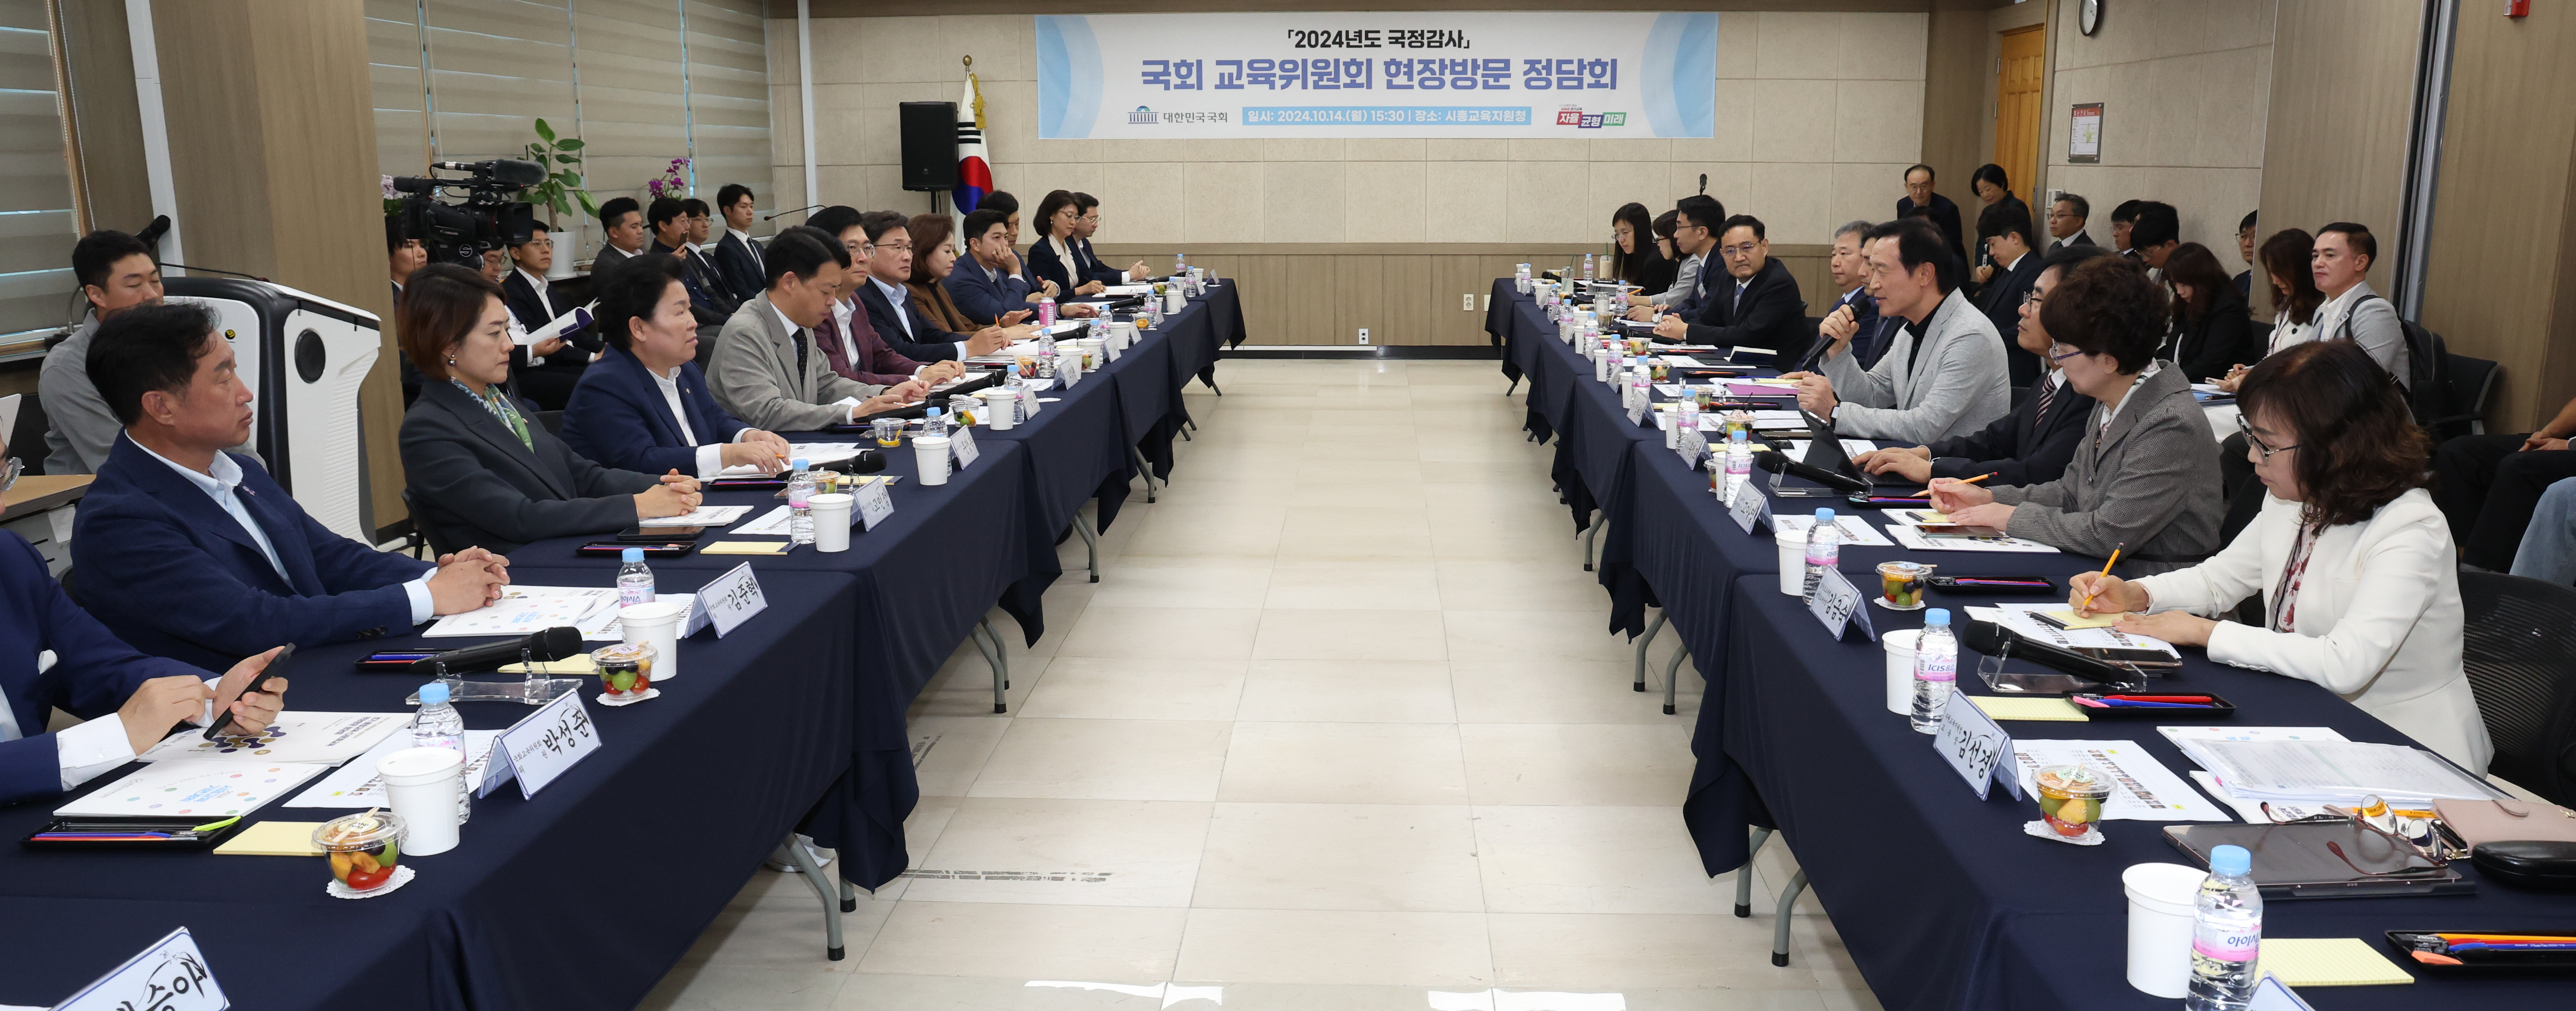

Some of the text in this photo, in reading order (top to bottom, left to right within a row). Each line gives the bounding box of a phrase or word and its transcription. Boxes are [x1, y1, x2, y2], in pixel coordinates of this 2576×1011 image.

[1142, 58, 1617, 90] 국회 교육위원회 현장방문 정담회
[1248, 110, 1526, 122] 일시: 2024.10.14.(월) 15:30 장소: 시흥교육지원청
[1559, 113, 1624, 127] 자율 균형 미래
[872, 489, 889, 512] 고민정
[1741, 502, 1757, 524] 고아영
[728, 578, 759, 611] 김준혁
[1826, 593, 1848, 627] 김금숙
[513, 711, 589, 762] 국회교육위원회 박성준
[1945, 713, 1993, 779] 수원교육지원청 김선경
[116, 962, 204, 1011] 승아
